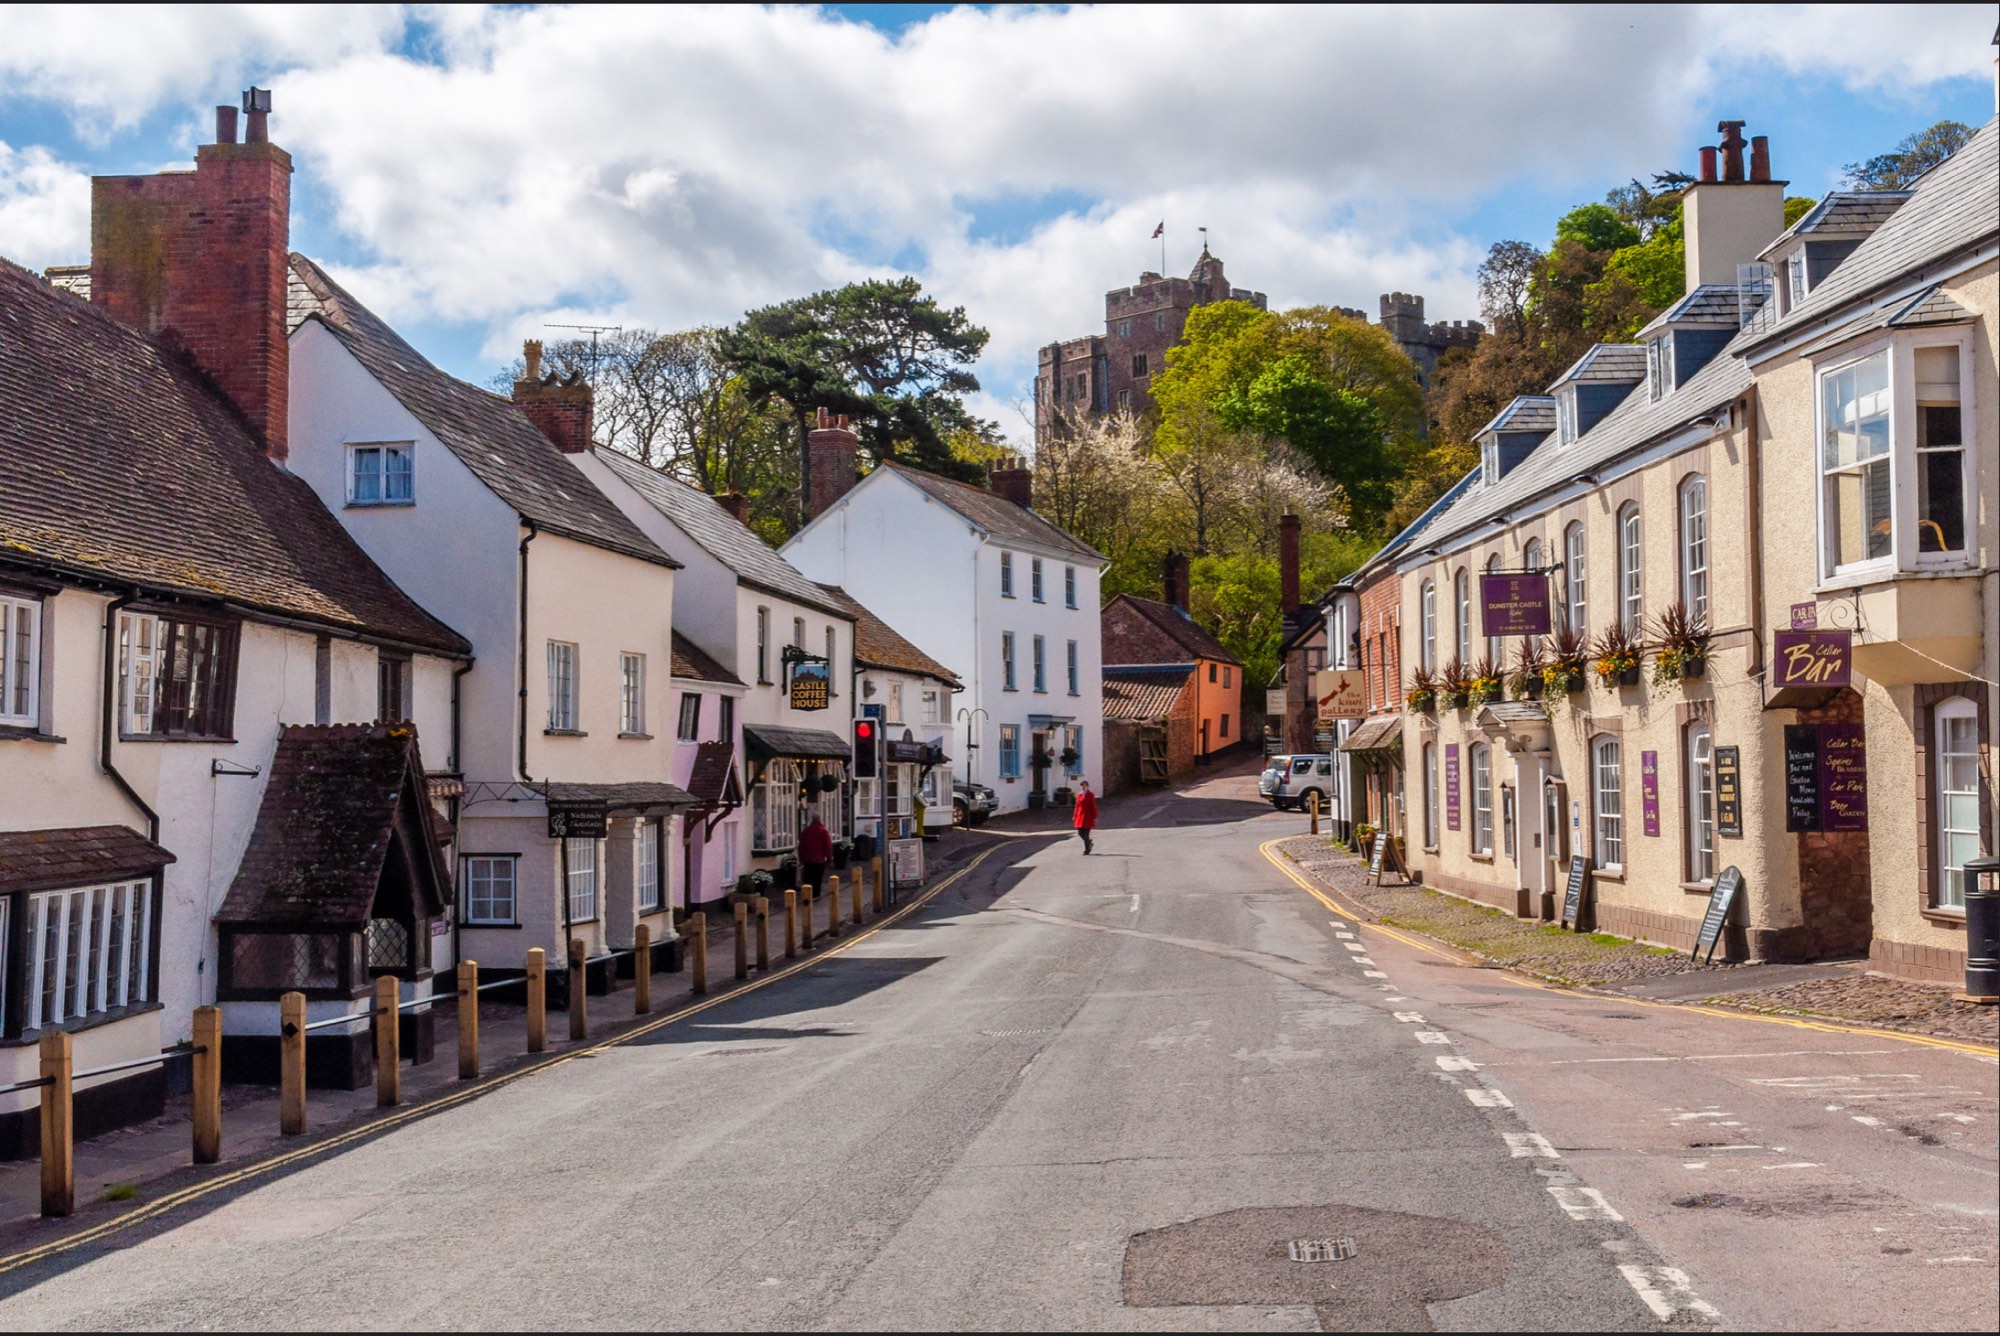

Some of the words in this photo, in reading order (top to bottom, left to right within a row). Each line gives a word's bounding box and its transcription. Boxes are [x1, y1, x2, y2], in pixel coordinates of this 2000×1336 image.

[1792, 607, 1808, 620] CAR
[1816, 644, 1842, 656] Cellar
[1783, 643, 1842, 683] Bar
[792, 682, 827, 690] CASTLE
[792, 691, 827, 699] COFFEE
[792, 700, 827, 708] HOUSE
[1338, 698, 1363, 706] kiwi
[1826, 738, 1849, 749] Cellar
[1850, 737, 1866, 748] Bar
[1788, 749, 1816, 760] Welcome
[1801, 762, 1813, 771] and
[1830, 781, 1845, 792] Car
[1846, 780, 1864, 793] Park
[1829, 799, 1849, 810] Beer
